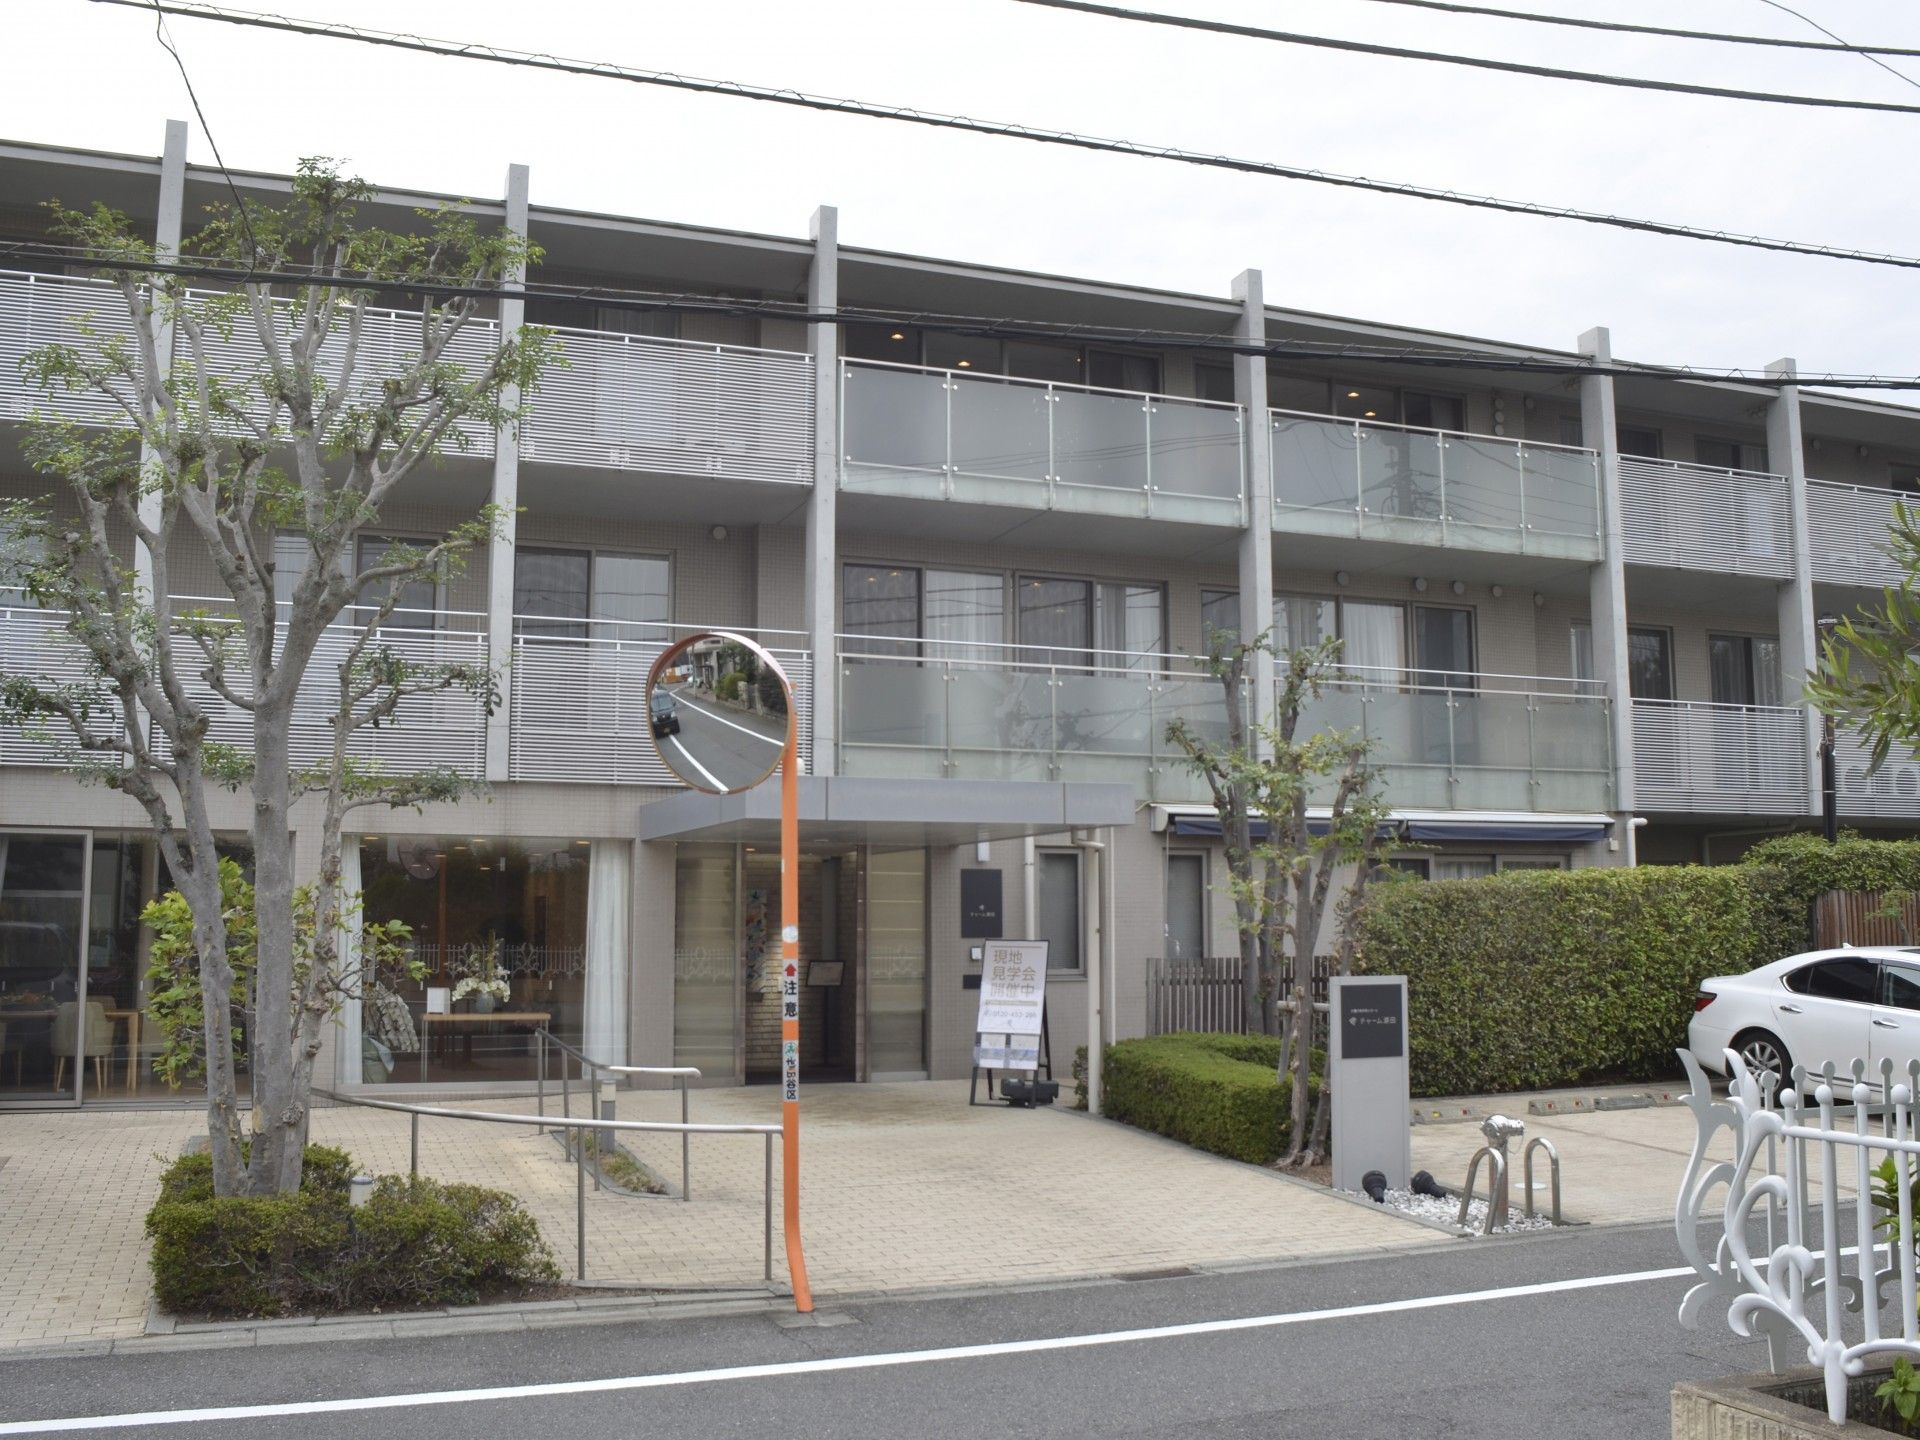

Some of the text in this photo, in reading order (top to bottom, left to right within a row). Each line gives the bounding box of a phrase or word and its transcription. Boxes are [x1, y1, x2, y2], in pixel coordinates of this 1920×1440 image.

[993, 950, 1023, 965] 現地
[992, 965, 1036, 981] 見学会
[990, 982, 1035, 998] 開催中
[783, 980, 798, 1018] 注意
